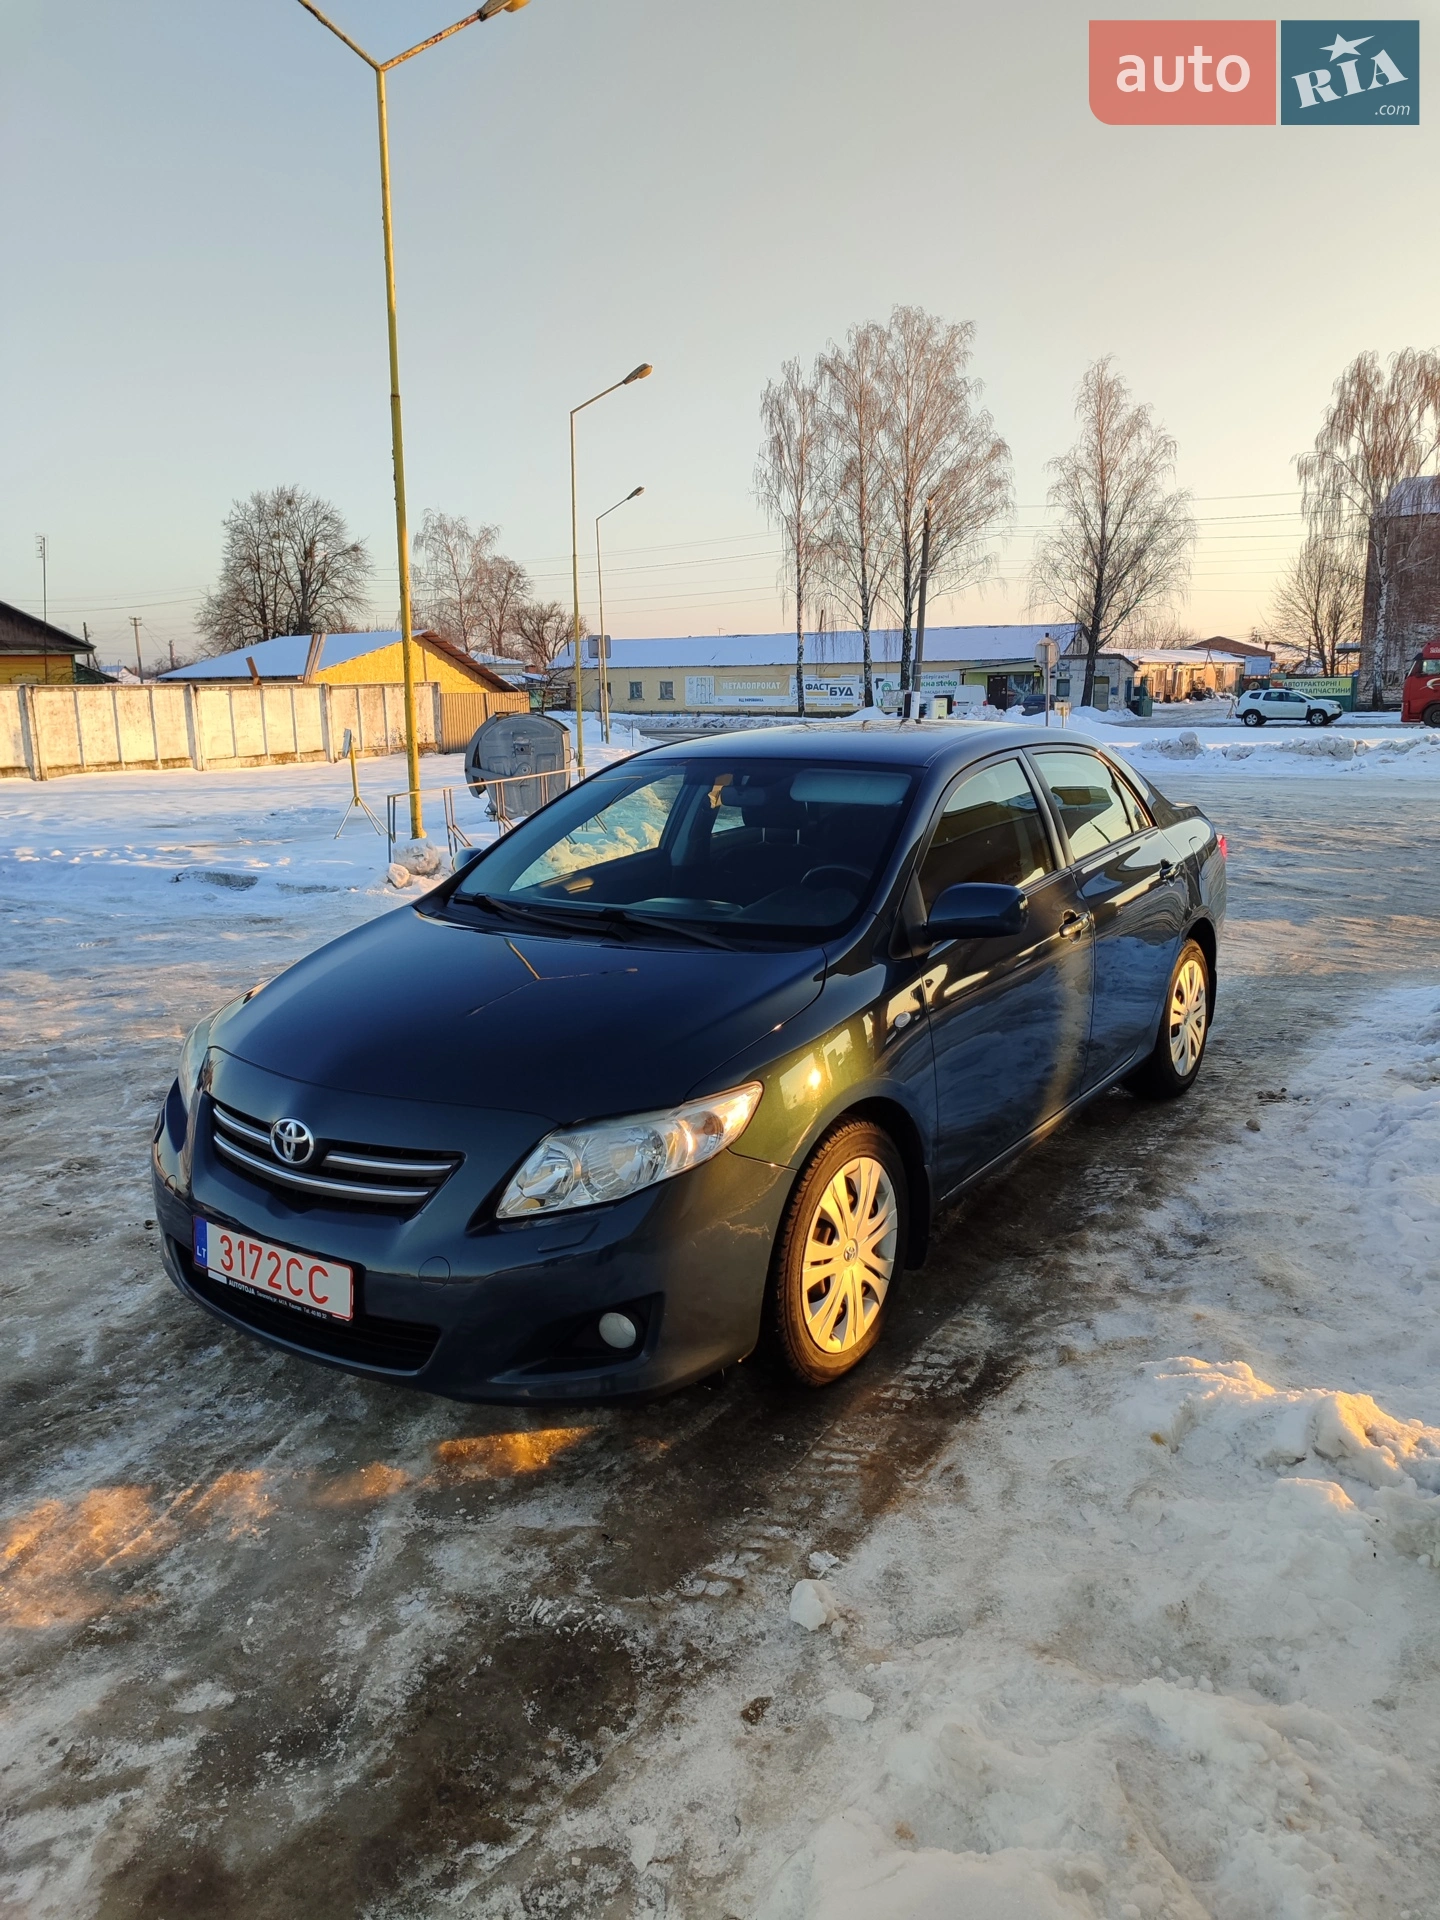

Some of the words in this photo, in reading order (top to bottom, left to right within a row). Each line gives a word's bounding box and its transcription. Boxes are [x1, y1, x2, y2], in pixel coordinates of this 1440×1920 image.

[722, 681, 781, 690] МЕТАЛОПРОКАТ
[805, 683, 830, 691] ФАСТ
[829, 687, 854, 696] БУД
[196, 1245, 207, 1259] LT
[219, 1234, 329, 1305] 3172CC
[228, 1279, 256, 1295] AUTOTOJA
